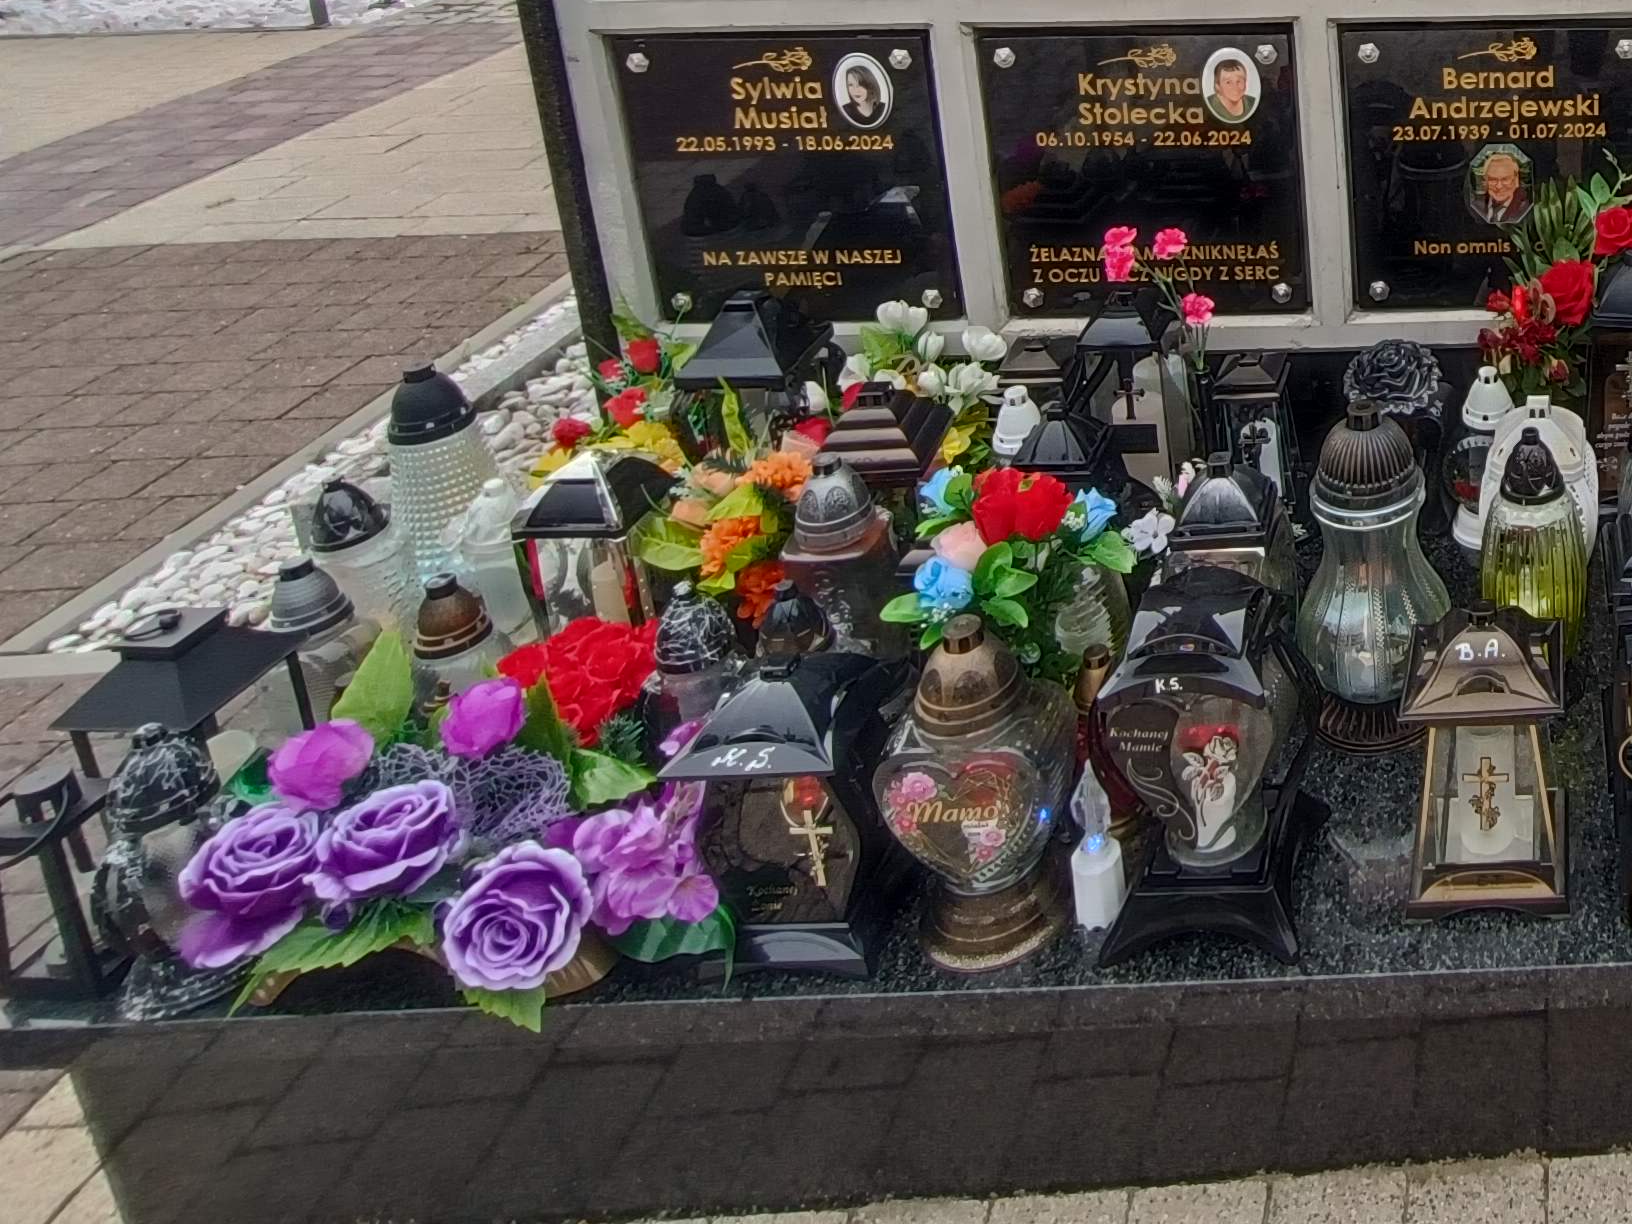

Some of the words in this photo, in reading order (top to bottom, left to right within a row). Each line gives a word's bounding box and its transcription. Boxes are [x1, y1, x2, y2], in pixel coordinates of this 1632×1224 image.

[1078, 72, 1204, 101] Krystyna
[1442, 65, 1554, 90] Bernard
[730, 75, 823, 105] Sylwia
[734, 101, 828, 129] Musiał
[1078, 97, 1208, 125] Stolecka
[1408, 93, 1600, 126] Andrzejewski
[1035, 131, 1135, 147] 06.10.1954
[1153, 130, 1252, 146] 22.06.2024
[1392, 124, 1490, 141] 23.07.1939
[1509, 120, 1607, 139] 01.07.2024
[675, 135, 777, 152] 22.05.1993
[795, 134, 894, 151] 18.06.2024
[1183, 240, 1281, 263] ZNIKNĘŁAŚ
[1414, 240, 1452, 255] Non
[1456, 236, 1514, 254] omnis
[702, 251, 733, 266] NA
[735, 250, 808, 266] ZAWSZE
[812, 250, 829, 265] W
[835, 249, 902, 265] NASZEJ
[764, 271, 843, 290] PAMIĘCI
[1032, 268, 1044, 283] Z
[1048, 267, 1101, 283] OCZU
[1154, 265, 1215, 283] NIGDY
[1218, 266, 1230, 281] Z
[1239, 266, 1280, 281] SERC
